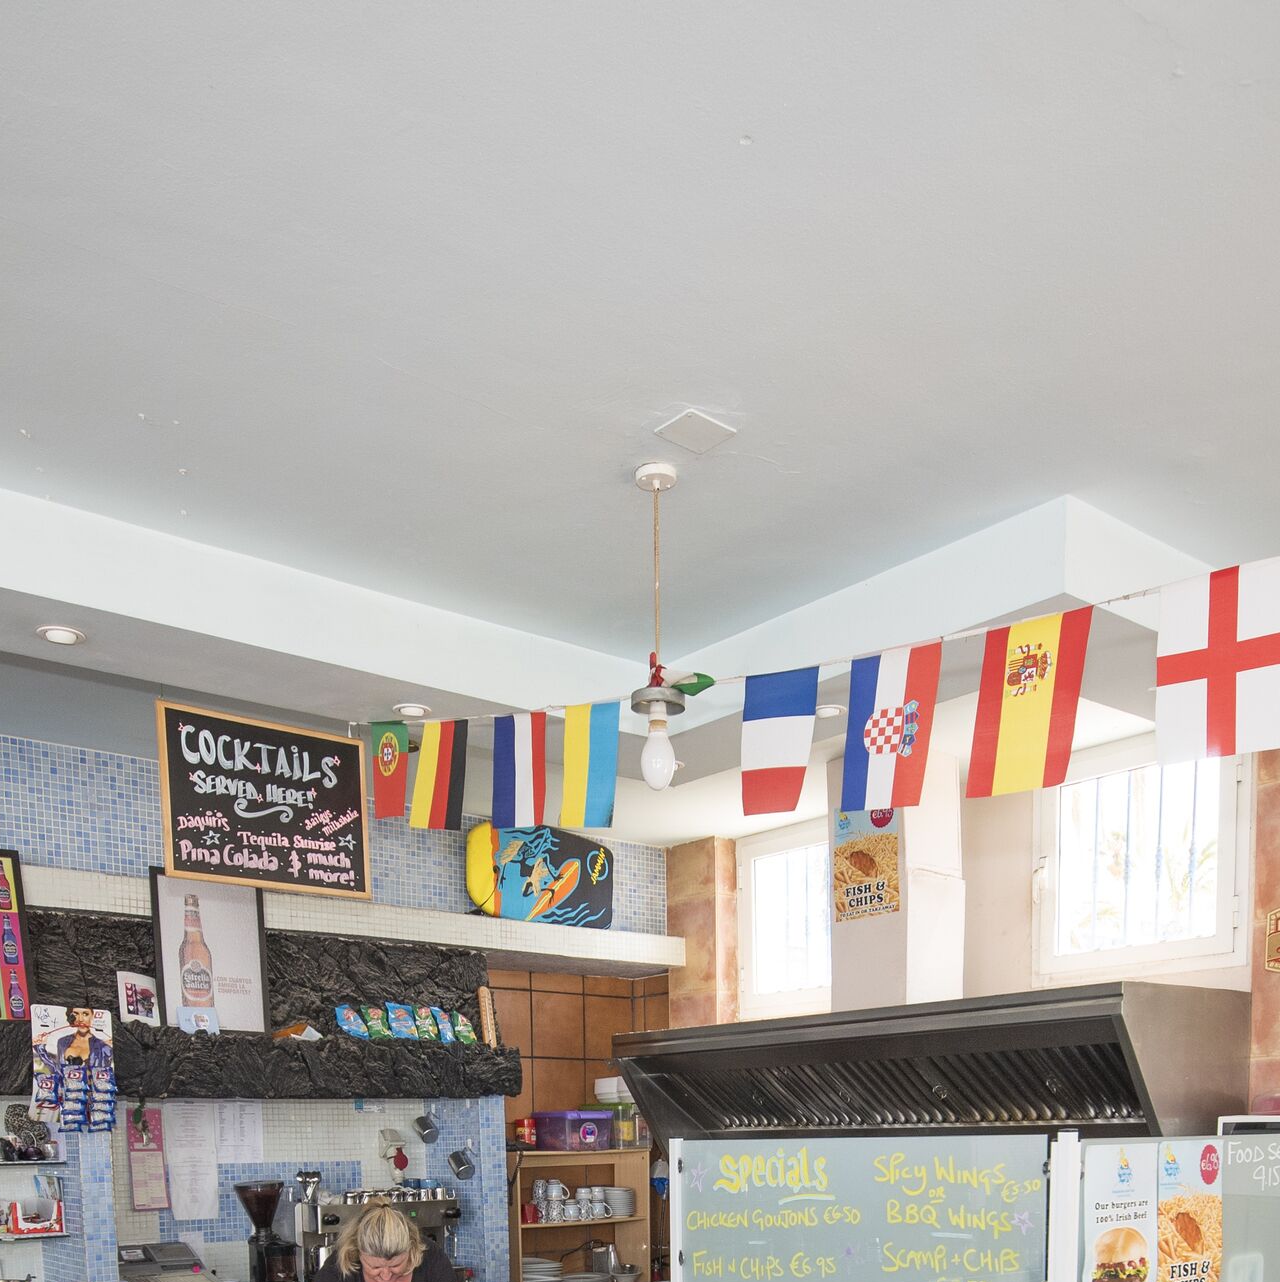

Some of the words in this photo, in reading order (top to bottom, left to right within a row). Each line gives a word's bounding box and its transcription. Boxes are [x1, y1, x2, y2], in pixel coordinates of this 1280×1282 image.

[181, 725, 338, 789] COCKTAILS
[193, 770, 258, 800] SERVED
[266, 784, 314, 809] HERE!
[177, 811, 230, 832] Daquiris
[237, 831, 290, 851] Tequila
[293, 834, 337, 852] Sunrise
[223, 844, 279, 872] Colada
[307, 851, 352, 869] much
[845, 884, 872, 898] FISH
[876, 881, 885, 892] &
[848, 893, 884, 909] CHIPS
[1227, 1141, 1265, 1165] FOOD
[928, 1186, 946, 1199] OR
[887, 1199, 941, 1230] BBQ
[1095, 1202, 1108, 1211] Our
[1111, 1200, 1137, 1210] burgers
[1116, 1211, 1132, 1222] Irish
[1133, 1210, 1148, 1220] Beef
[1170, 1261, 1199, 1279] FISH
[1201, 1260, 1211, 1274] &
